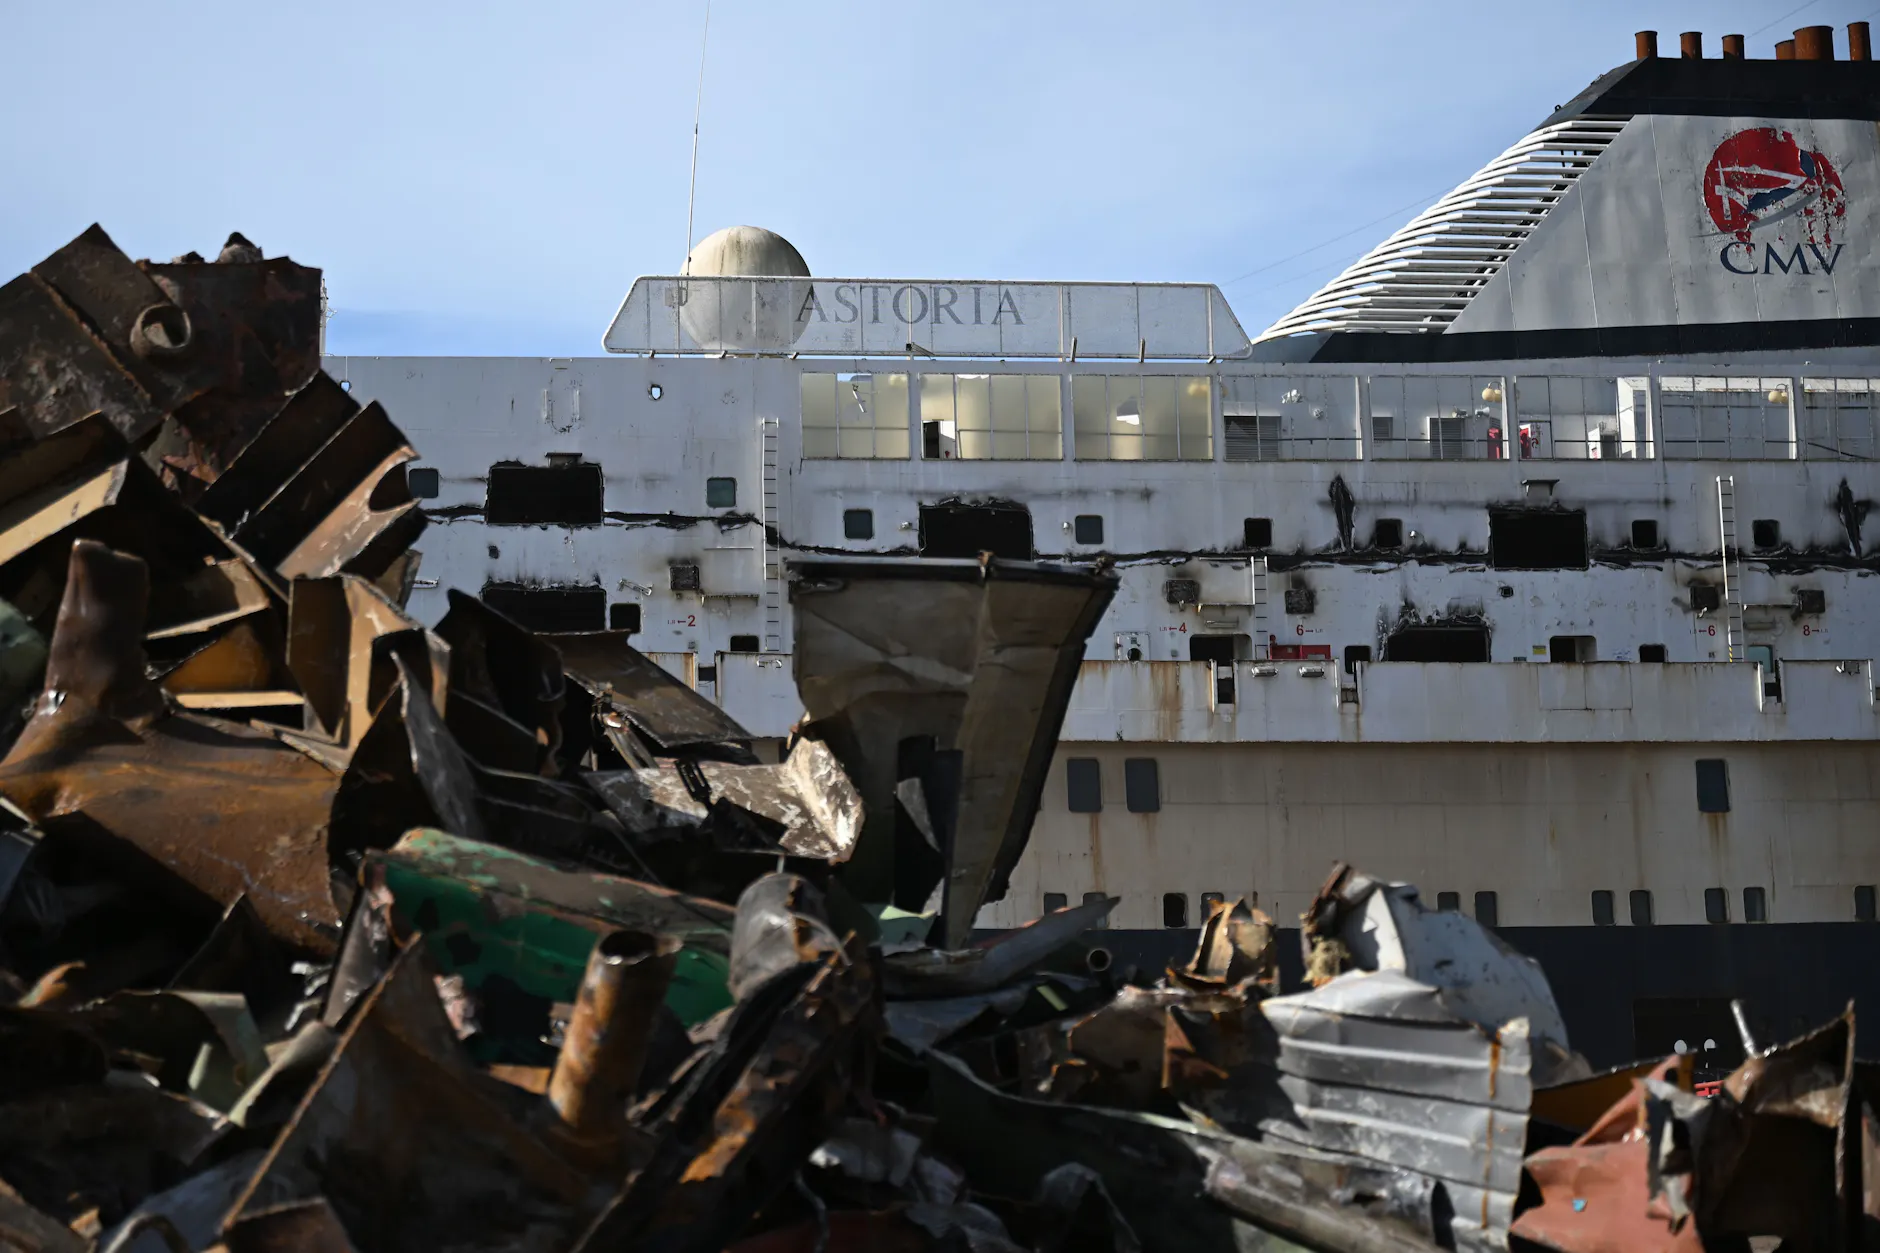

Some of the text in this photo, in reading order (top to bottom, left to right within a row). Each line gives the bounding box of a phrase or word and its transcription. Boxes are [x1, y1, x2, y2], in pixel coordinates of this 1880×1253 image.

[1720, 241, 1846, 275] CMV
[795, 284, 1025, 325] ASTORIA
[687, 614, 696, 627] 2
[1178, 622, 1187, 633] 4
[1296, 624, 1304, 636] 6
[1708, 624, 1716, 636] 6
[1803, 624, 1810, 636] 8
